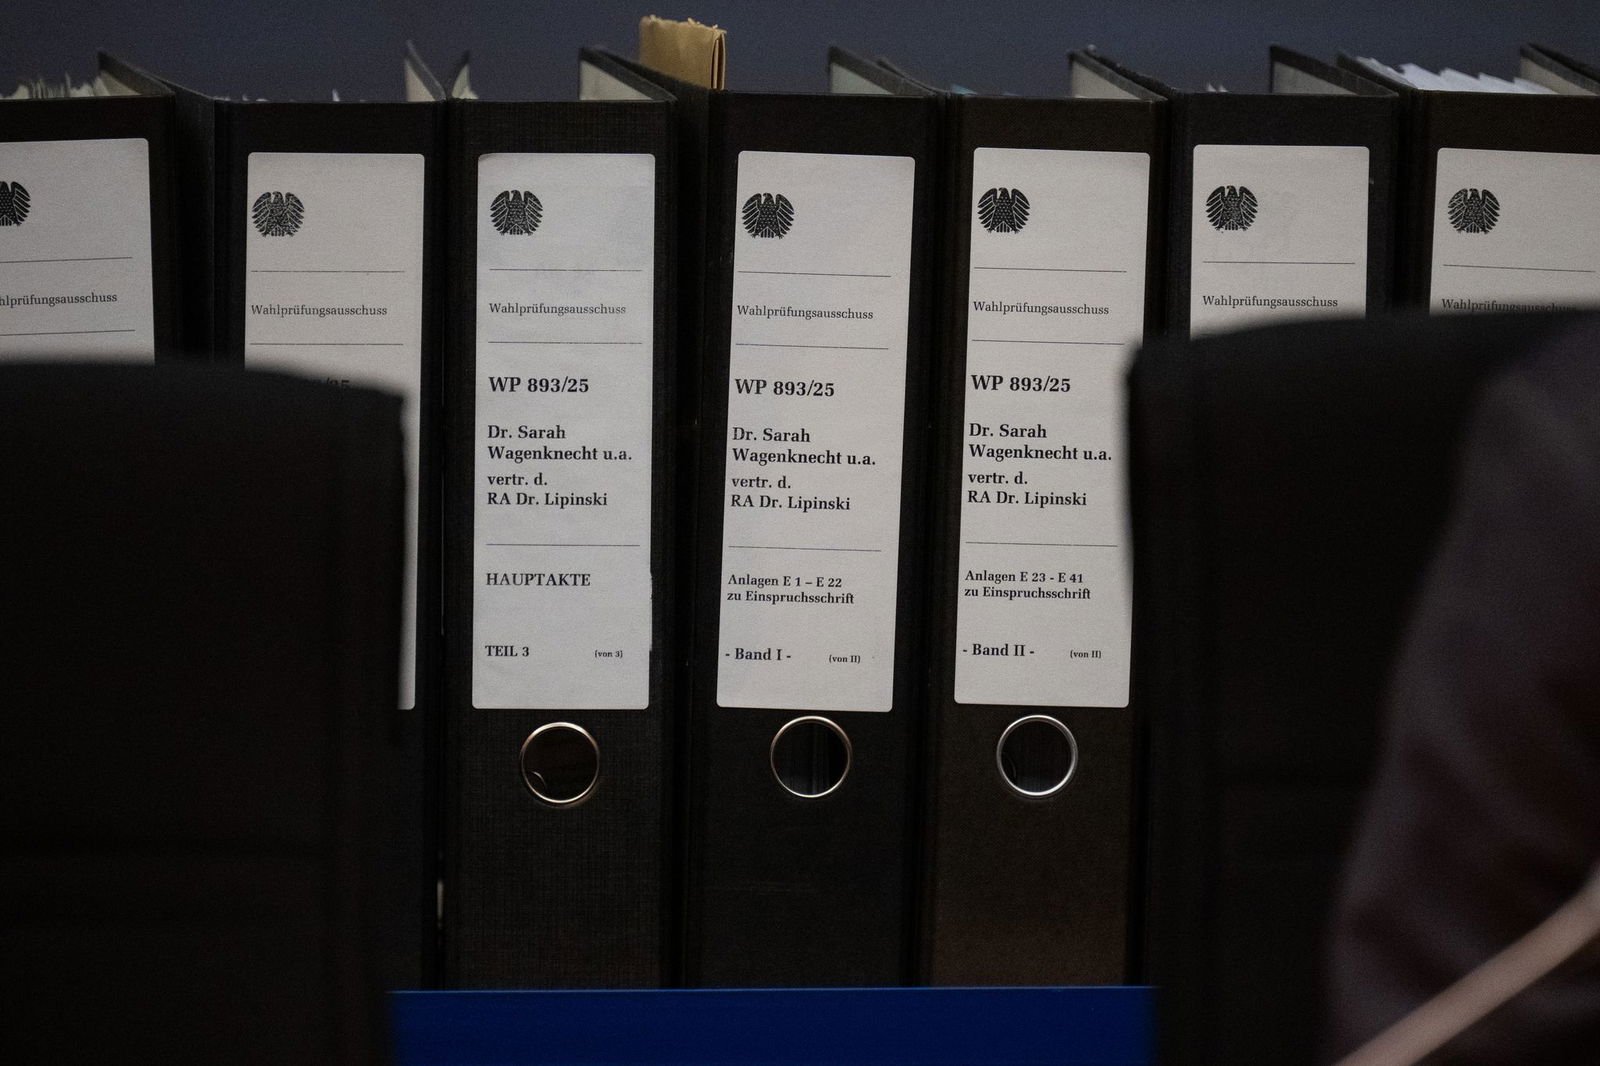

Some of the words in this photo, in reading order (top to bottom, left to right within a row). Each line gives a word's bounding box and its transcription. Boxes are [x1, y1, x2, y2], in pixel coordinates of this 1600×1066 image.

[489, 303, 626, 316] Wahlprüfungsausschuss
[974, 301, 1109, 316] Wahlprüfungsausschuss
[1203, 295, 1337, 309] Wahlprüfungsausschuss
[252, 304, 387, 318] Wahlprüfungsausschuss
[737, 305, 873, 320] Wahlprüfungsausschuss
[488, 377, 522, 393] WP
[528, 376, 589, 393] 893/25
[735, 379, 768, 395] WP
[773, 380, 834, 397] 893/25
[971, 375, 1004, 391] WP
[1010, 375, 1070, 392] 893/25
[488, 425, 513, 439] Dr.
[518, 425, 566, 439] Sarah
[733, 427, 758, 442] Dr.
[763, 428, 811, 442] Sarah
[970, 423, 994, 438] Dr.
[999, 424, 1047, 438] Sarah
[487, 446, 598, 464] Wagenknecht
[603, 451, 632, 460] u.a.
[733, 447, 842, 466] Wagenknecht
[847, 455, 875, 465] u.a.
[969, 444, 1078, 462] Wagenknecht
[1083, 450, 1111, 460] u.a.
[487, 474, 528, 485] vertr.
[534, 472, 548, 486] d.
[732, 476, 772, 488] vertr.
[778, 475, 792, 490] d.
[968, 473, 1009, 485] vertr.
[1014, 471, 1028, 485] d.
[487, 492, 512, 506] RA
[516, 492, 540, 506] Dr.
[544, 492, 607, 509] Lipinski
[731, 494, 756, 508] RA
[759, 495, 783, 509] Dr.
[787, 496, 850, 513] Lipinski
[968, 490, 992, 504] RA
[996, 491, 1020, 505] Dr.
[1024, 491, 1087, 509] Lipinski
[486, 573, 590, 586] HAUPTAKTE
[728, 574, 779, 589] Anlagen
[783, 576, 792, 587] E
[795, 577, 801, 588] 1
[816, 577, 825, 588] E
[828, 578, 843, 589] 22
[965, 570, 1016, 584] Anlagen
[1019, 572, 1029, 583] E
[1031, 572, 1047, 583] 23
[1058, 572, 1067, 584] E
[1069, 573, 1084, 584] 41
[727, 593, 742, 601] zu
[745, 590, 855, 606] Einspruchsschrift
[965, 589, 979, 597] zu
[982, 586, 1091, 602] Einspruchsschrift
[485, 645, 518, 657] TEIL
[522, 646, 530, 658] 3
[595, 650, 613, 658] (von
[615, 650, 624, 660] 3)
[735, 648, 772, 660] Band
[776, 649, 783, 662] I
[972, 643, 1009, 656] Band
[1013, 644, 1027, 657] II
[1070, 650, 1088, 659] (von
[1092, 650, 1102, 660] II)
[829, 654, 847, 663] (von
[851, 655, 861, 665] II)
